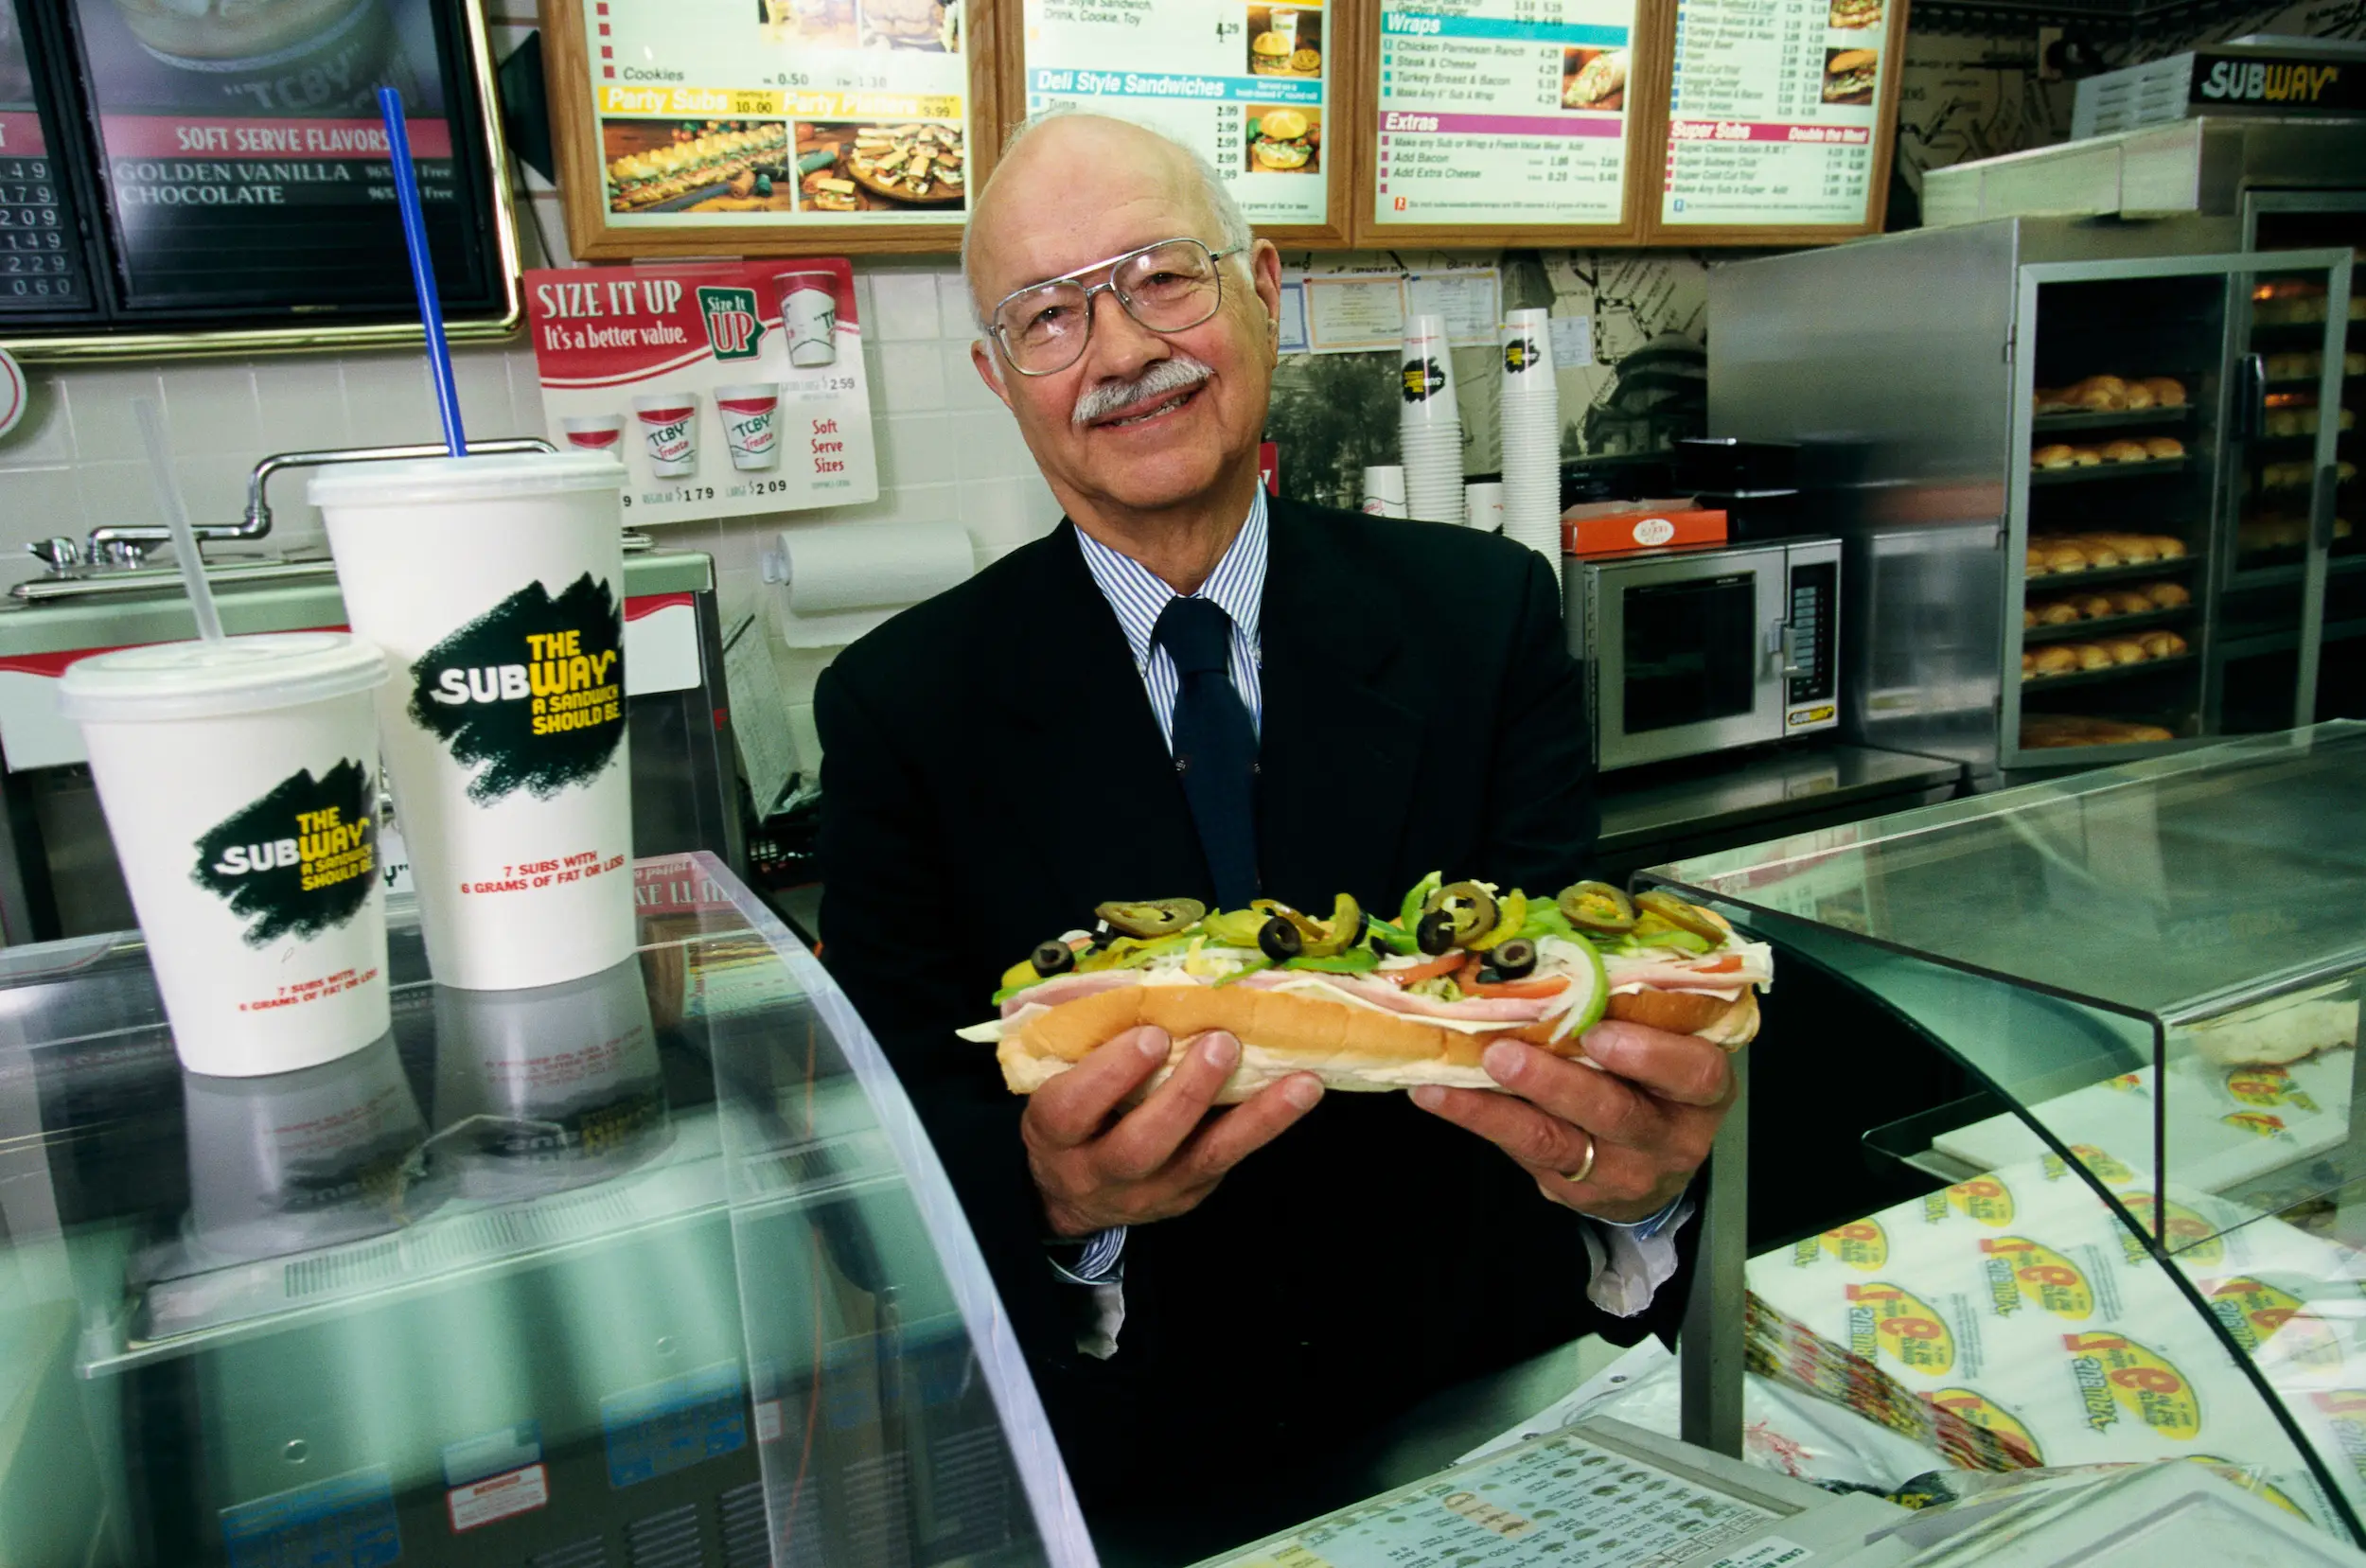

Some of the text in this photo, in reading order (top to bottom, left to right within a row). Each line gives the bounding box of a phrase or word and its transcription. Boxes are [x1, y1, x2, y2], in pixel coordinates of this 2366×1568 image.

[1124, 12, 1140, 26] Toy
[1387, 13, 1441, 35] Wraps
[624, 67, 684, 80] Cookies
[1439, 58, 1476, 69] Cheese
[778, 73, 809, 86] 0.50
[1038, 71, 1225, 97] Deli Style Sandwiches
[1397, 71, 1431, 84] Turkey
[1479, 75, 1510, 86] Bacon
[2200, 60, 2339, 101] SUBWAY
[608, 87, 728, 114] Party Subs
[783, 92, 837, 117] Party
[1385, 113, 1439, 132] Extras
[1671, 121, 1715, 139] Super
[176, 126, 228, 151] SOFT
[236, 127, 302, 152] SERVE
[1394, 152, 1449, 164] Add Bacon
[115, 162, 351, 183] GOLDEN VANILLA
[1393, 167, 1481, 179] Add Extra Cheese
[120, 185, 285, 204] CHOCOLATE
[537, 279, 682, 320] SIZE IT UP
[707, 294, 746, 311] Size It
[543, 321, 688, 351] It's a better value.
[709, 312, 754, 353] UP
[812, 419, 838, 434] Soft
[811, 438, 844, 454] Serve
[814, 458, 844, 474] Sizes
[526, 629, 581, 661] THE
[429, 649, 617, 705] SUBWAY
[532, 683, 620, 715] A SANDWICH
[532, 700, 622, 736] SHOULD BE
[296, 806, 341, 835] THE
[213, 818, 370, 875] SUBWAY
[300, 862, 312, 875] A
[461, 854, 625, 894] 6 GRAMS OF FAT OR LESS
[503, 850, 599, 878] 7 SUBS WITH
[301, 866, 359, 891] SHOULD
[291, 979, 325, 994] SUBS
[327, 968, 356, 983] WITH
[252, 996, 299, 1011] GRAMS
[303, 993, 317, 1002] OF
[323, 985, 341, 997] FAT
[344, 978, 360, 990] OR
